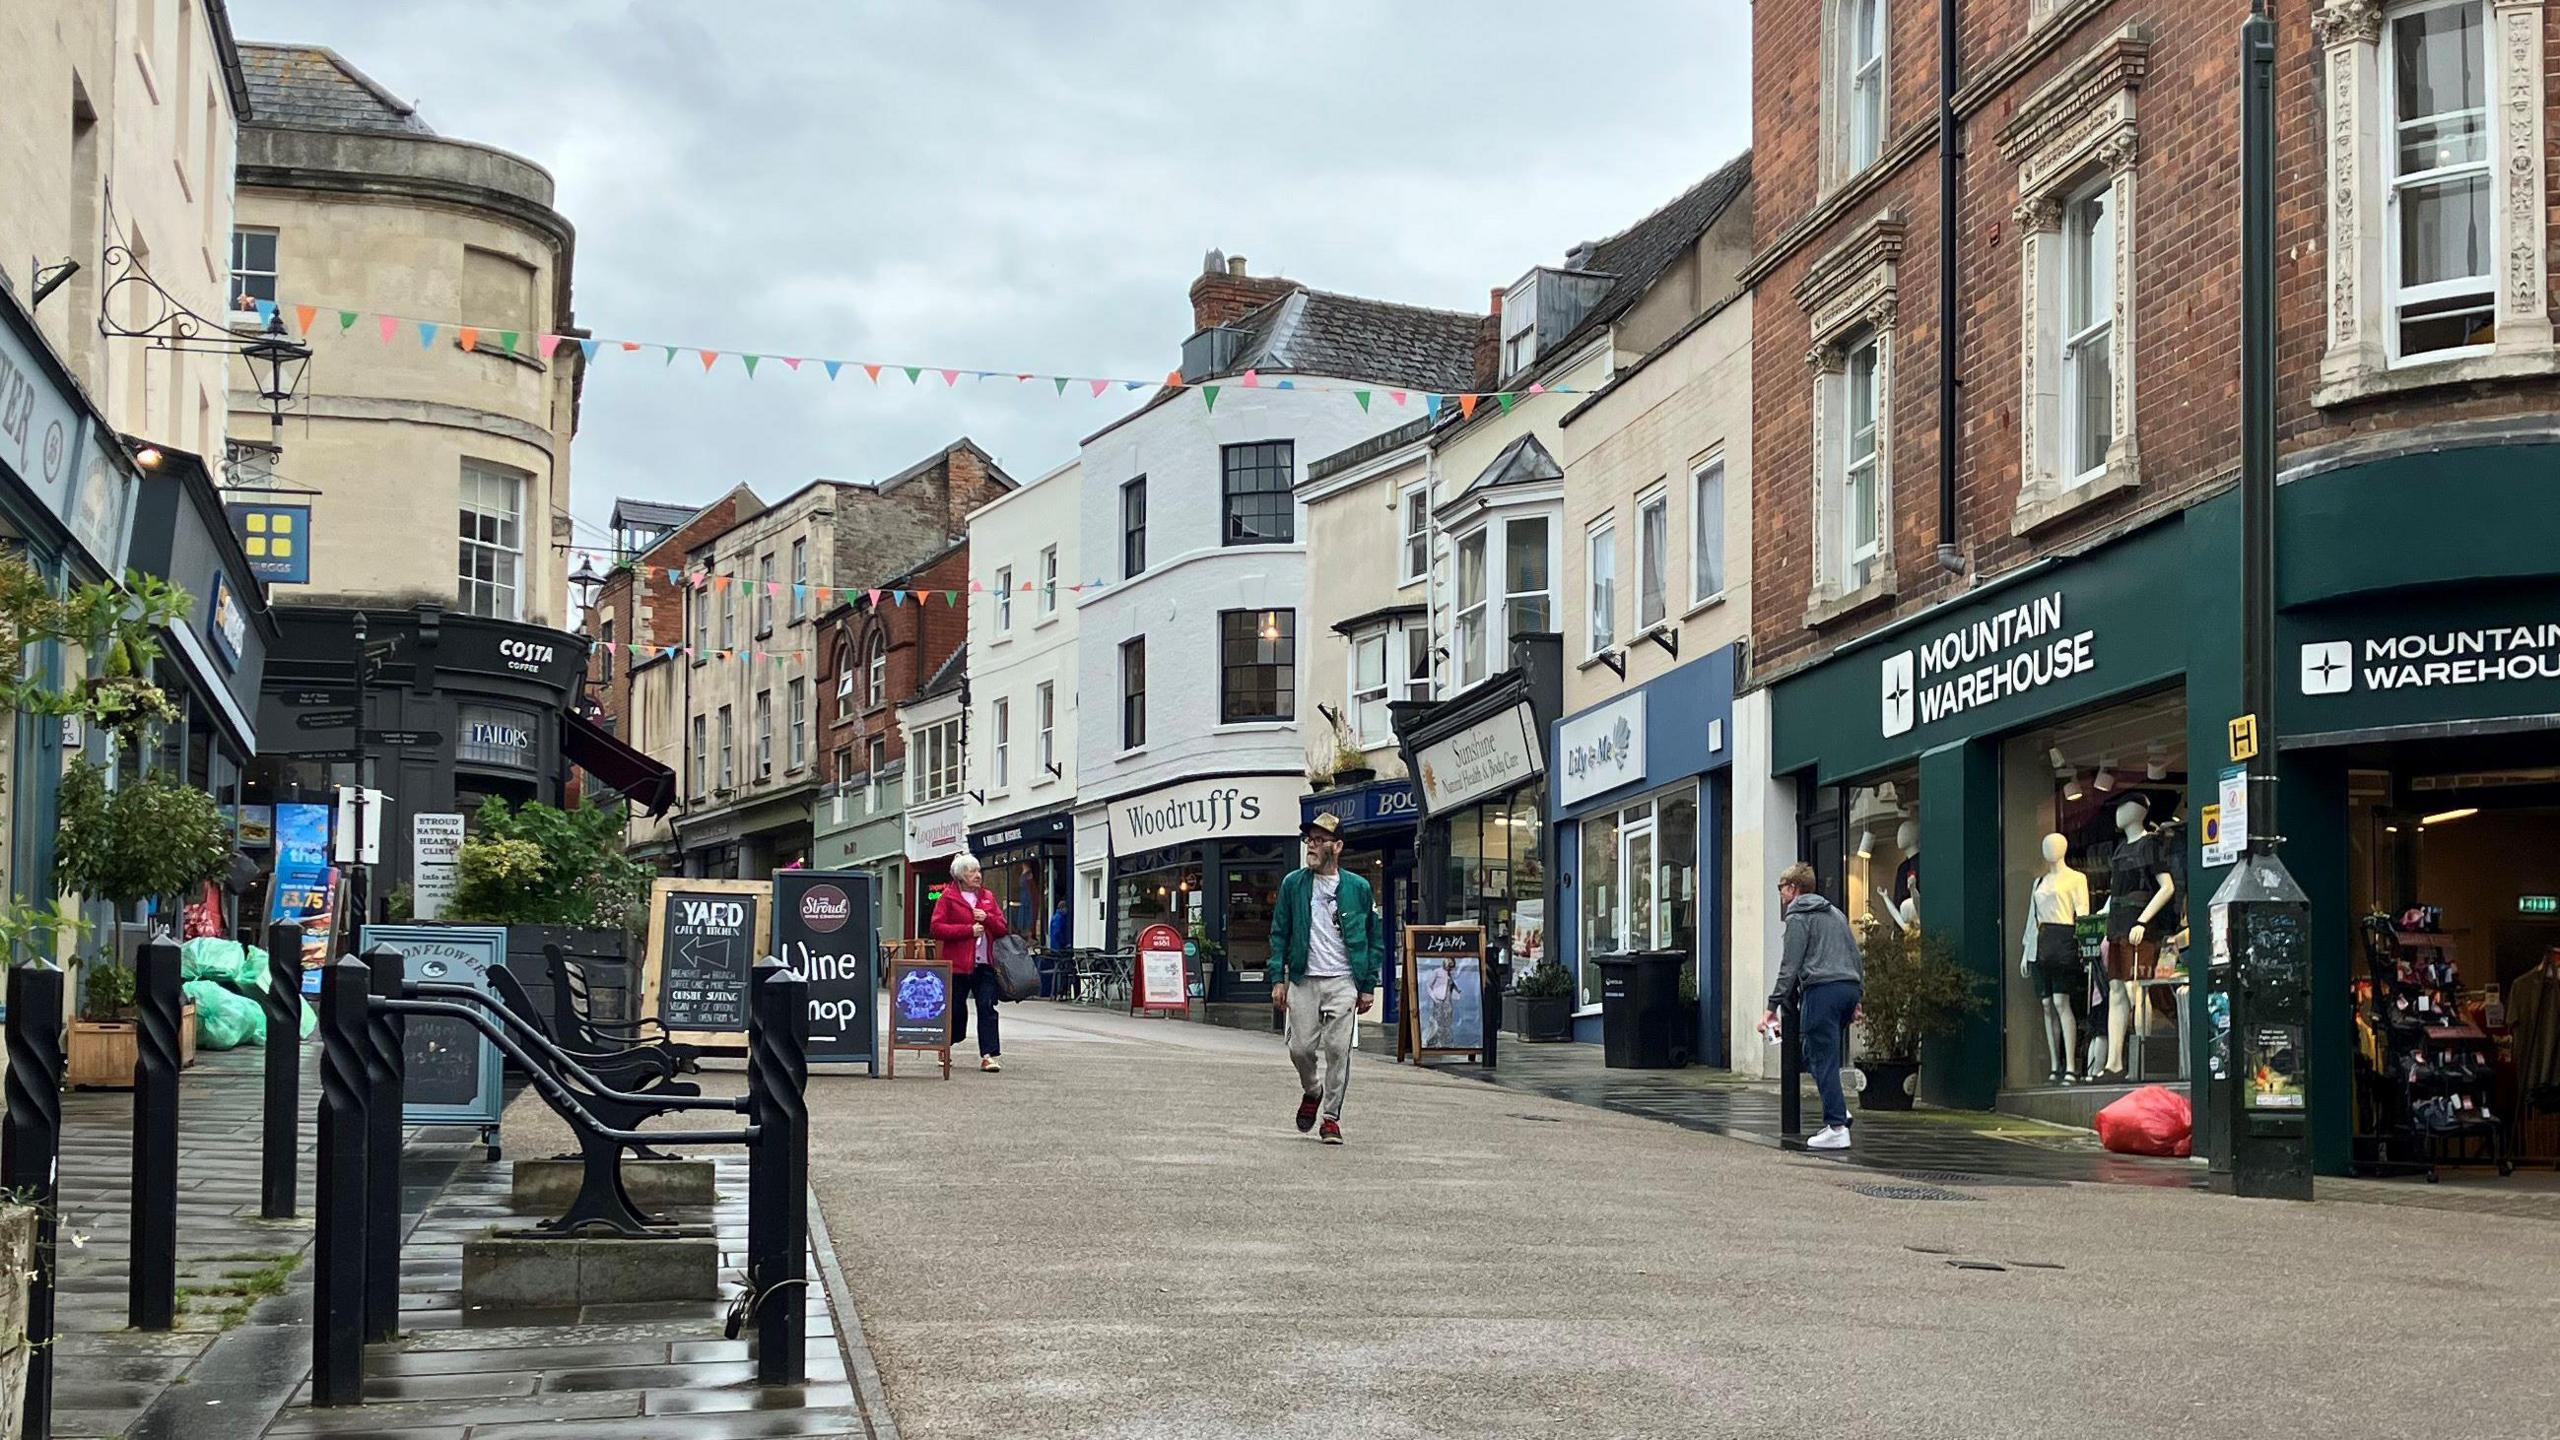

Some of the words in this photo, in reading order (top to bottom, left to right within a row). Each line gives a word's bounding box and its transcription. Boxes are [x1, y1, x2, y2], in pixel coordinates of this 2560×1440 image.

[500, 639, 553, 663] COSTA
[1920, 591, 2061, 679] MOUNTAIN
[508, 661, 539, 673] COFFEE
[1919, 629, 2094, 724] WAREHOUSE
[474, 723, 528, 749] TAILORS
[1451, 730, 1497, 769] Sunshine
[2232, 720, 2252, 757] H
[1126, 788, 1262, 838] Woodruffs
[682, 901, 744, 928] YARD
[802, 896, 848, 914] Stroud
[781, 941, 856, 981] Wine
